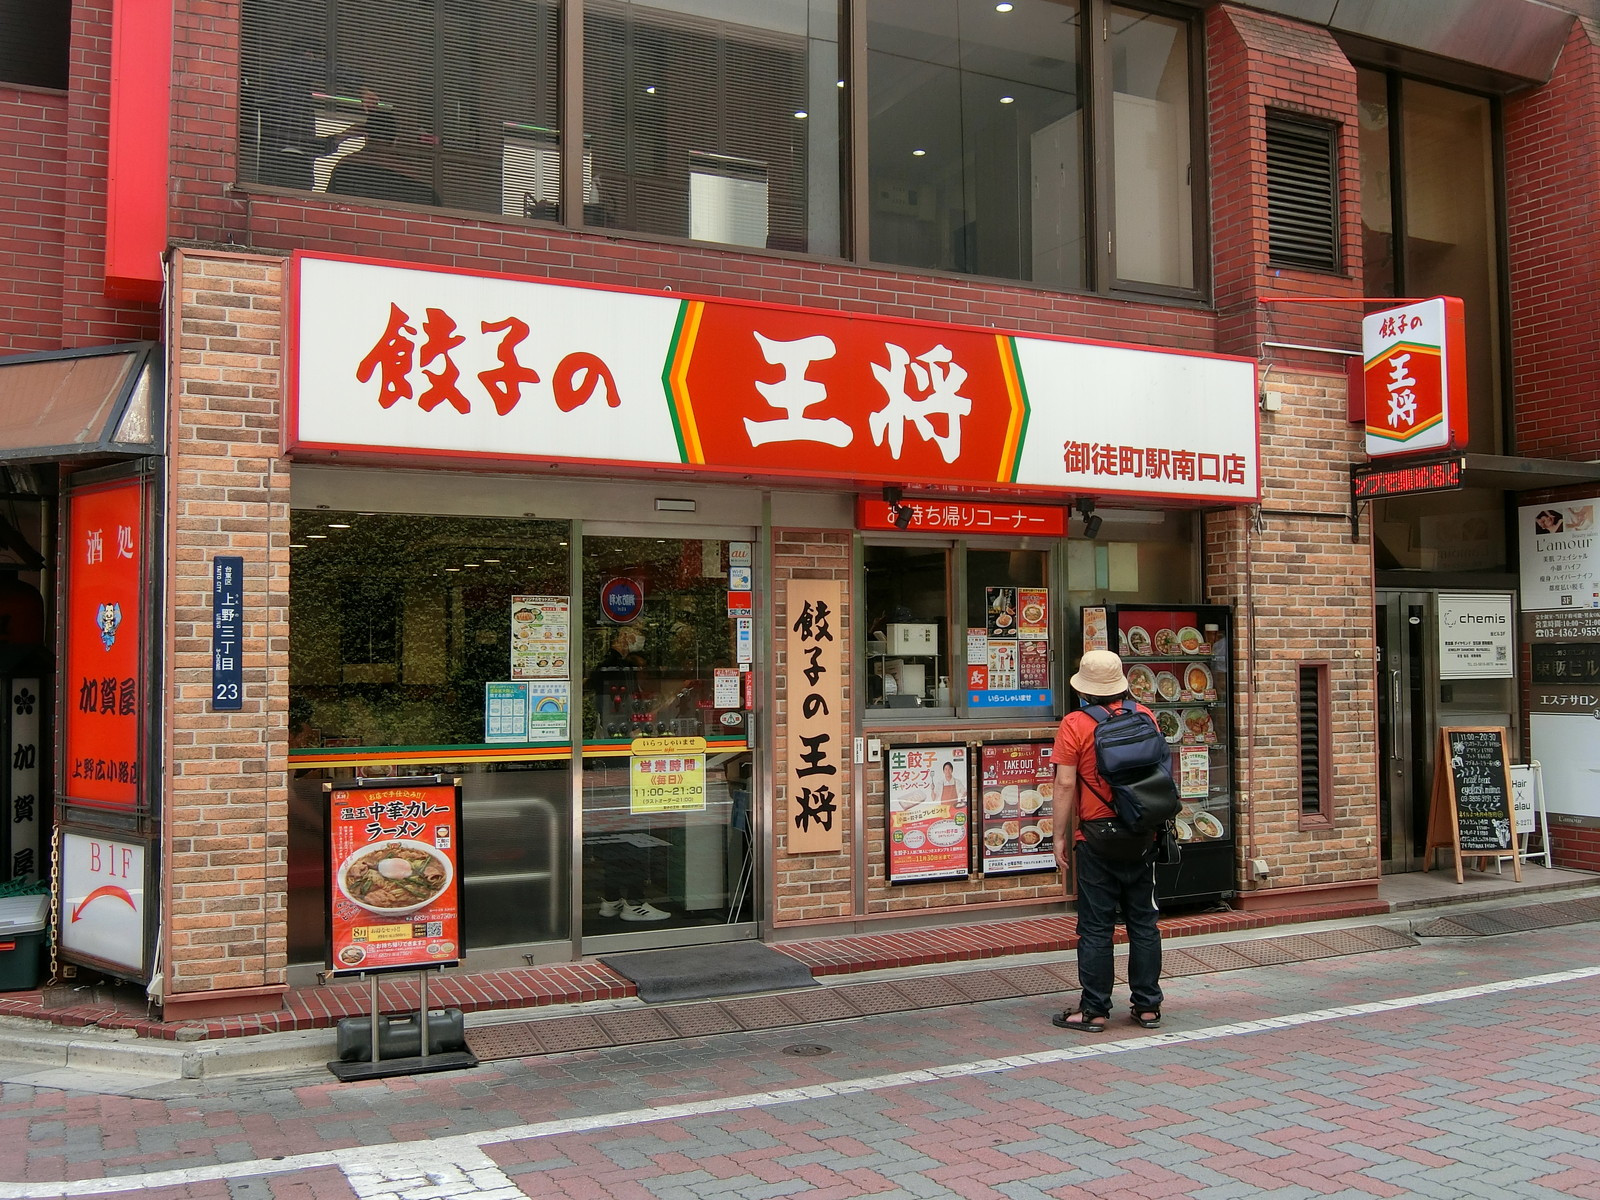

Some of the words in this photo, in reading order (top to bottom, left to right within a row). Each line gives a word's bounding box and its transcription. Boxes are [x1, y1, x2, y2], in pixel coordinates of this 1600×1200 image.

[1379, 313, 1423, 339] 餃子の
[356, 302, 621, 415] 餃子の
[743, 330, 973, 464] 王将
[1386, 353, 1418, 428] 王将
[1063, 439, 1247, 484] 御徒町駅南口店
[86, 525, 134, 565] 酒処
[731, 550, 748, 558] au
[1536, 538, 1593, 553] L'amour
[1556, 553, 1588, 561] フェイシャル
[224, 565, 232, 586] 台東区
[1562, 596, 1571, 605] 3F
[1459, 613, 1505, 624] chemis
[221, 592, 235, 671] 上野三丁目
[80, 677, 136, 716] 加賀屋
[217, 683, 238, 700] 23
[988, 694, 1032, 703] いらっしゃいませ
[1540, 694, 1599, 706] エステサロン
[793, 600, 837, 833] 餃子の王将
[642, 738, 695, 746] いらっしゃいませ
[640, 758, 696, 773] 営業時間
[891, 751, 937, 770] 生餃子
[1003, 760, 1019, 770] TAKE
[1020, 759, 1034, 769] OUT
[892, 769, 930, 783] スタンプ
[1511, 780, 1527, 788] Hair
[892, 781, 931, 791] キャンペーン
[13, 744, 36, 878] 加賀屋
[341, 800, 451, 821] 温玉中華カレー
[365, 820, 427, 841] ラーメン
[90, 842, 133, 879] B1F
